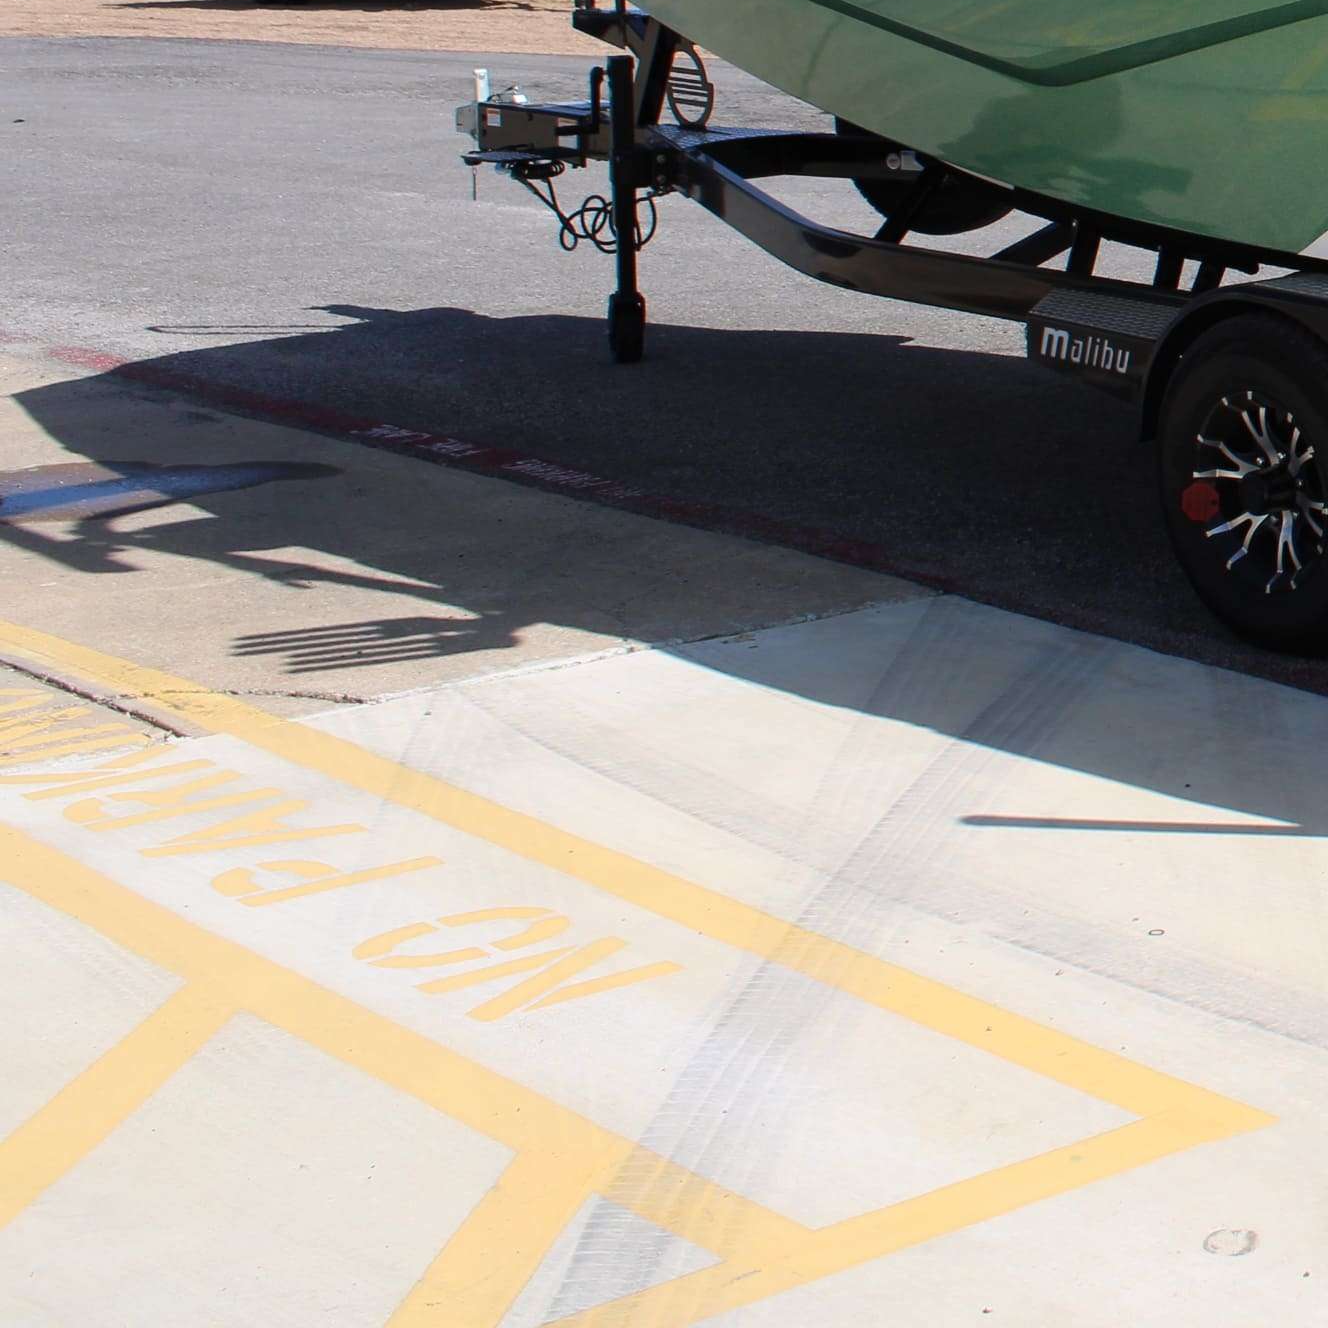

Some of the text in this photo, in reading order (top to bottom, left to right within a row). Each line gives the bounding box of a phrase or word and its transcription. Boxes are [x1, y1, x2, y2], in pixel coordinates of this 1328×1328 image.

[1040, 326, 1130, 374] Malibu
[0, 688, 687, 1023] NO PARKIN
